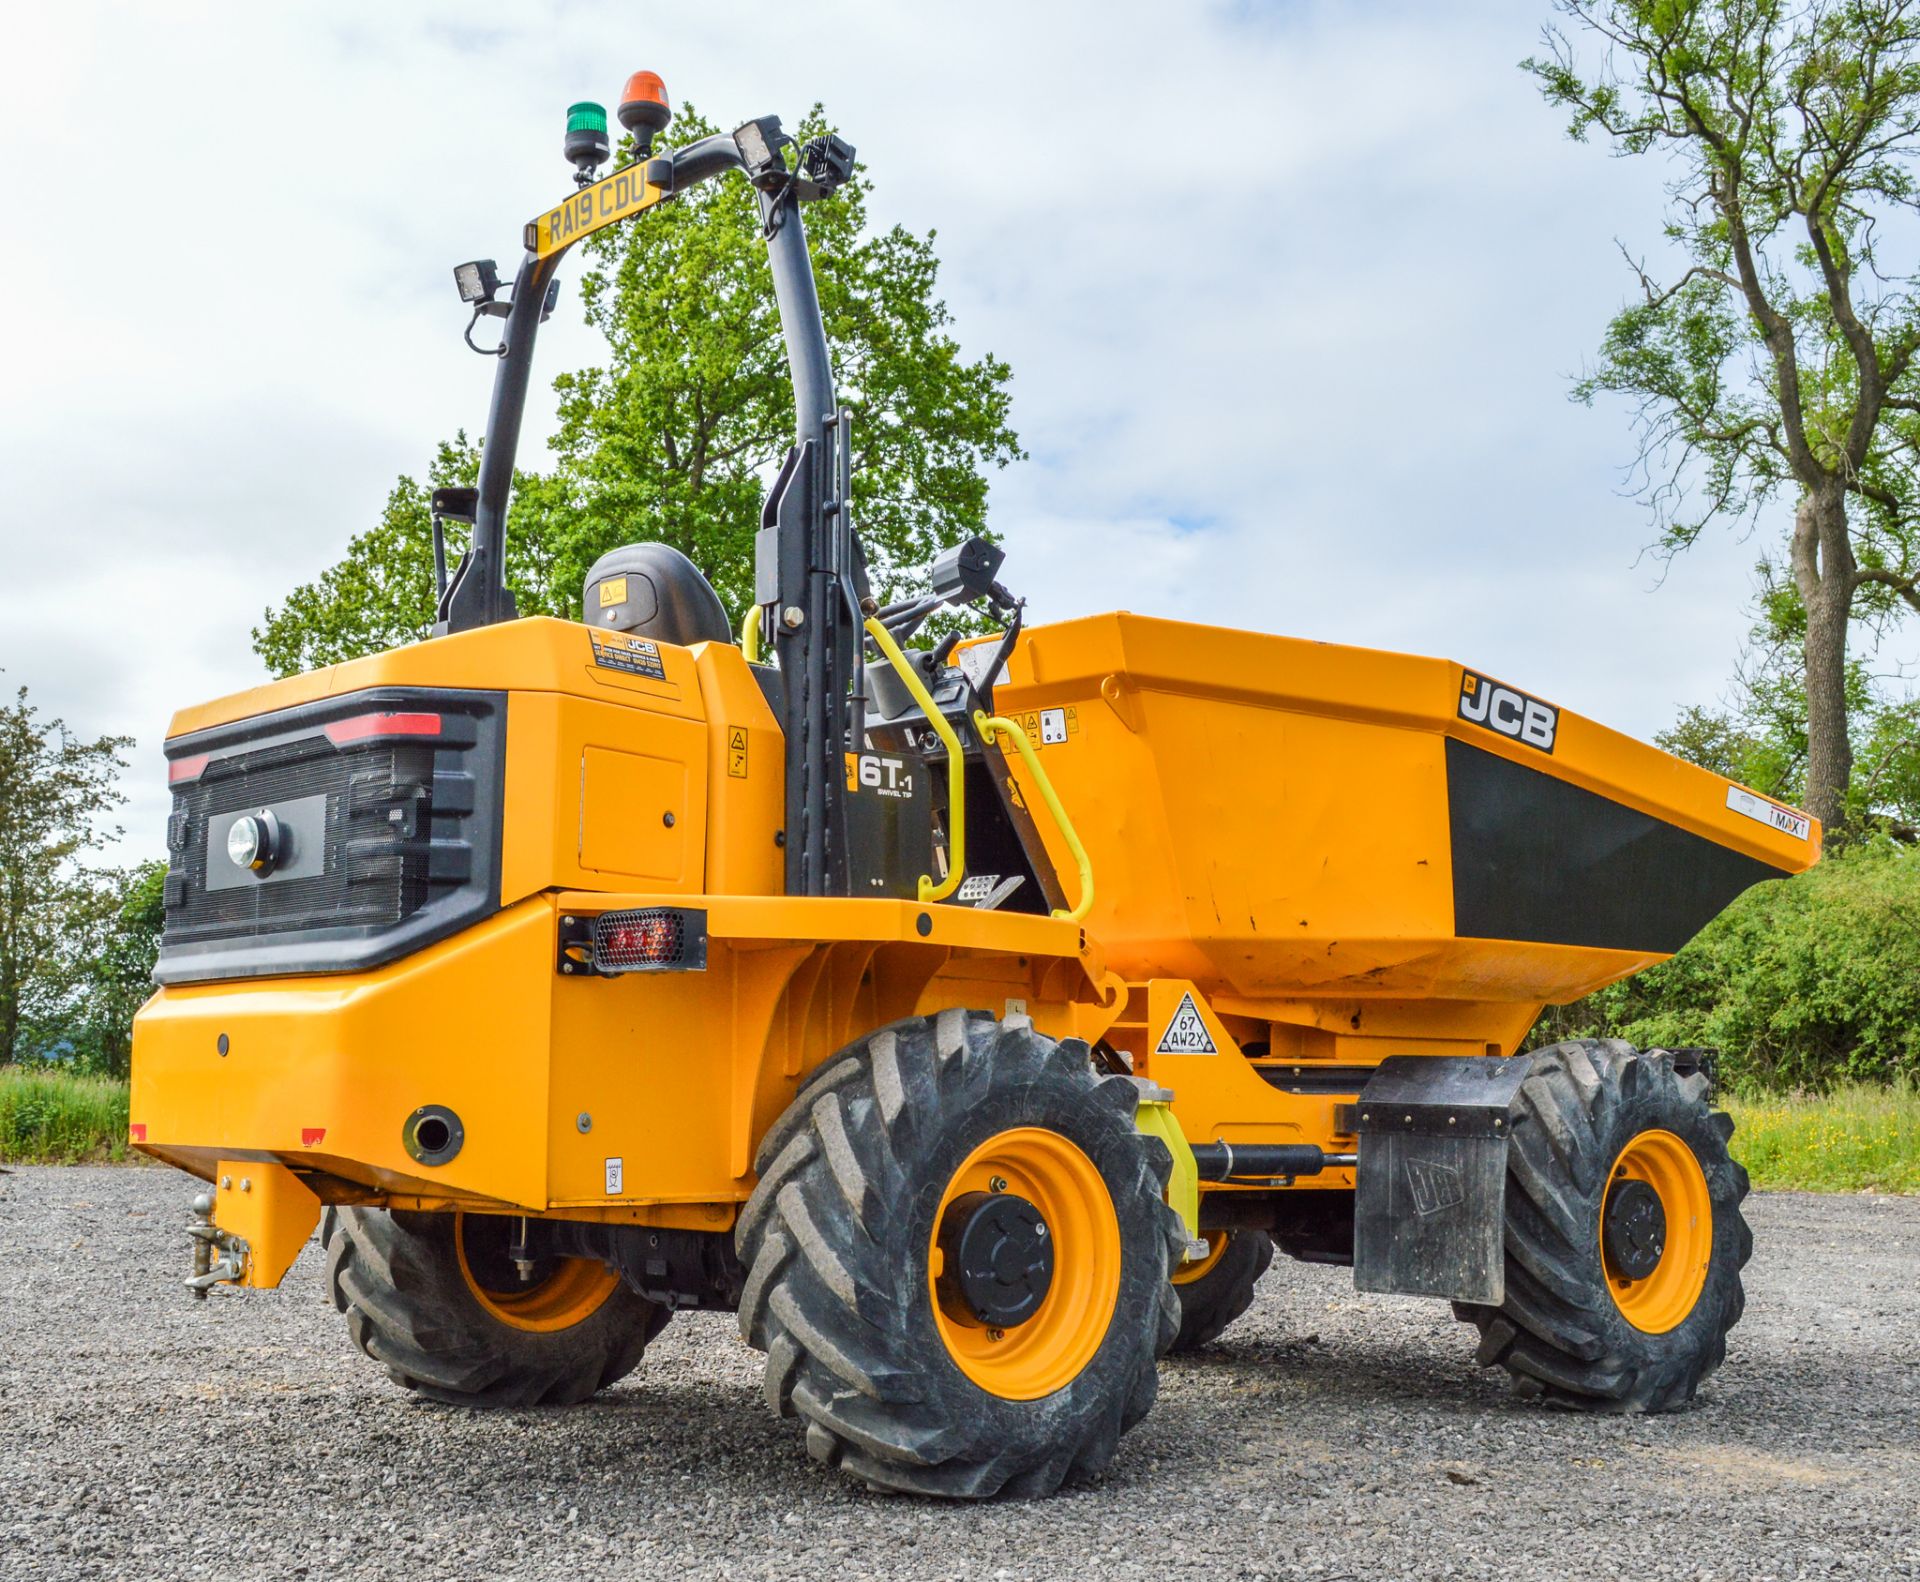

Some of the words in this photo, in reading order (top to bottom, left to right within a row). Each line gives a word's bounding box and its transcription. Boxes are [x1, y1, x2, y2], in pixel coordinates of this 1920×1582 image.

[550, 192, 593, 245] RA19
[599, 166, 646, 217] CDU
[627, 639, 656, 654] JCB
[1460, 681, 1556, 749] JCB
[1179, 1016, 1196, 1031] 67
[1171, 1031, 1204, 1047] AW2X
